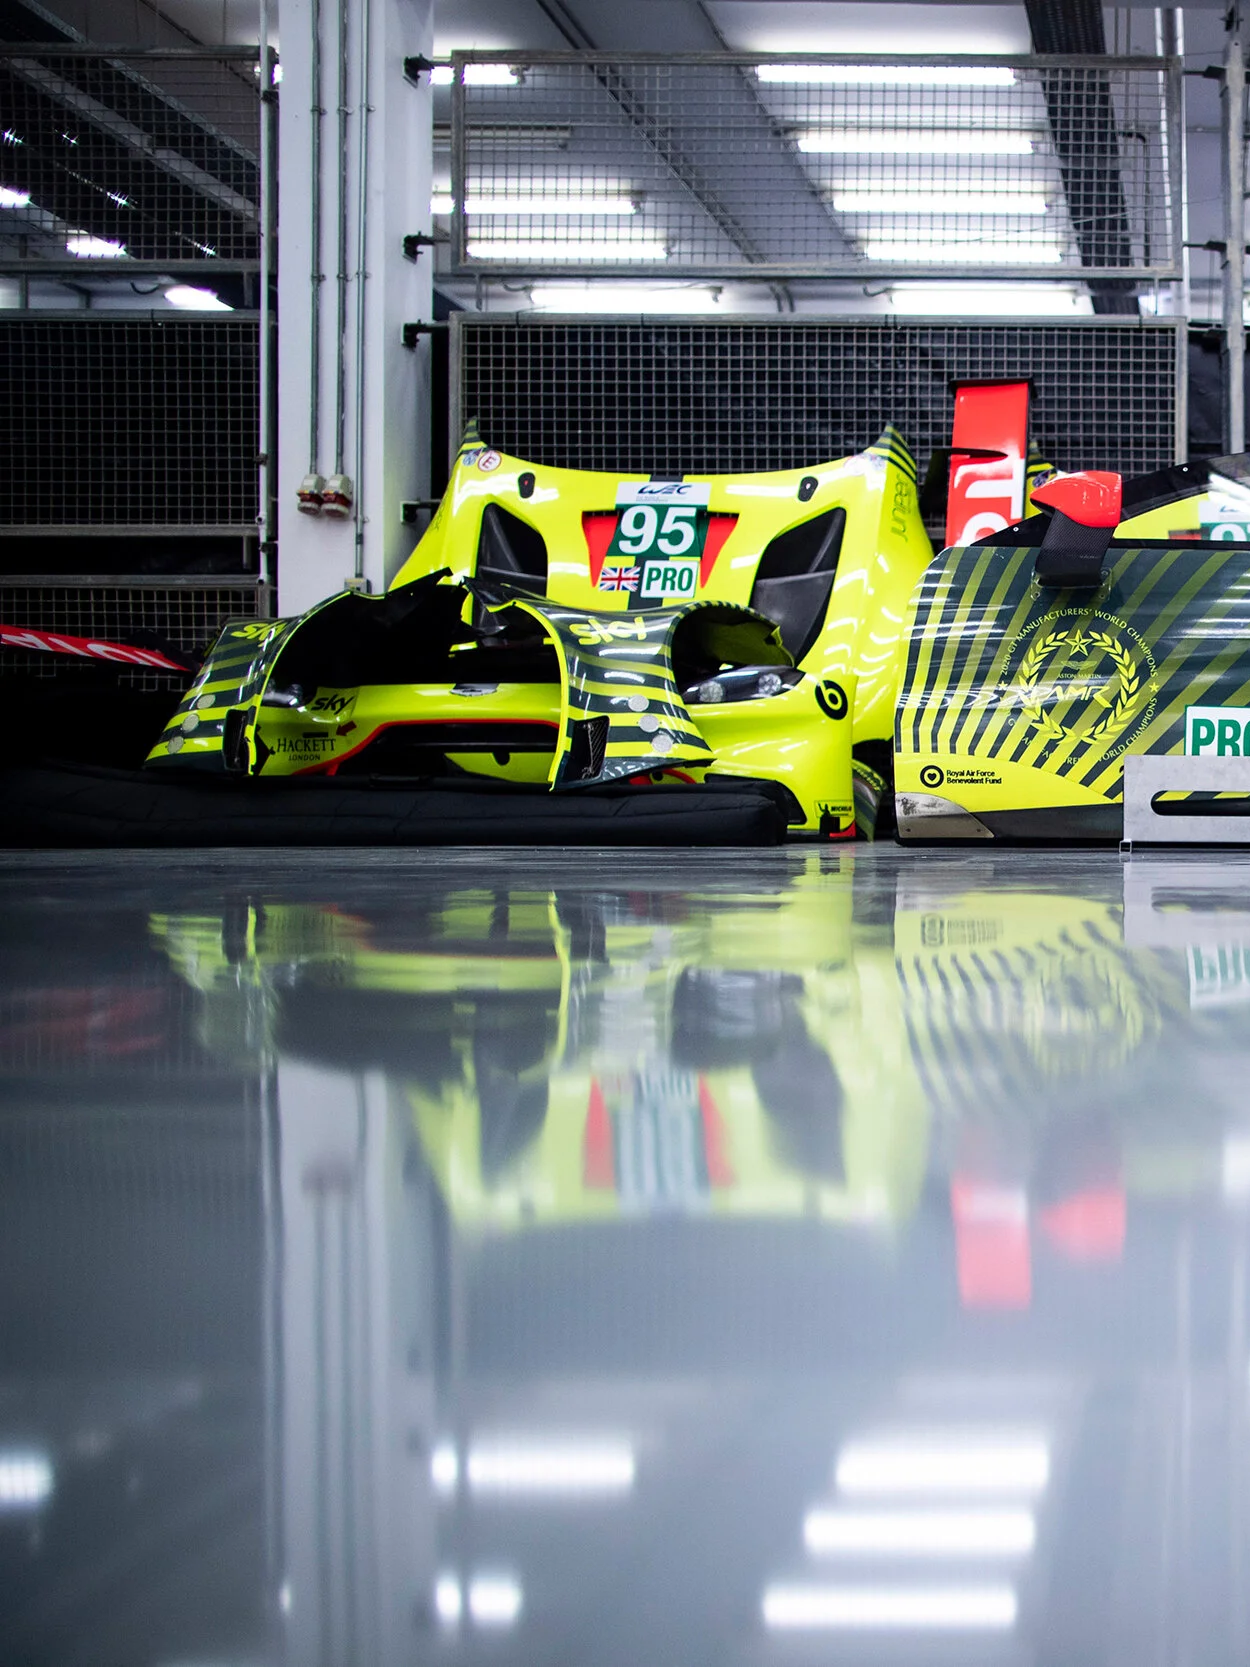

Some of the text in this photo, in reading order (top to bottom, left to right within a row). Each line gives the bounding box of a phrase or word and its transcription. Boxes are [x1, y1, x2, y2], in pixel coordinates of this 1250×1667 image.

[618, 505, 697, 555] 95
[645, 567, 694, 591] PRO
[569, 616, 647, 645] sky
[1000, 654, 1012, 676] 2020
[1008, 639, 1018, 653] GT
[1094, 610, 1127, 629] WORLD
[1127, 627, 1159, 678] CHAMPIONS
[311, 694, 355, 714] sky
[1125, 697, 1158, 747] CHAMPIONS
[277, 739, 336, 752] HACKETT
[946, 769, 995, 778] Royal Air Force
